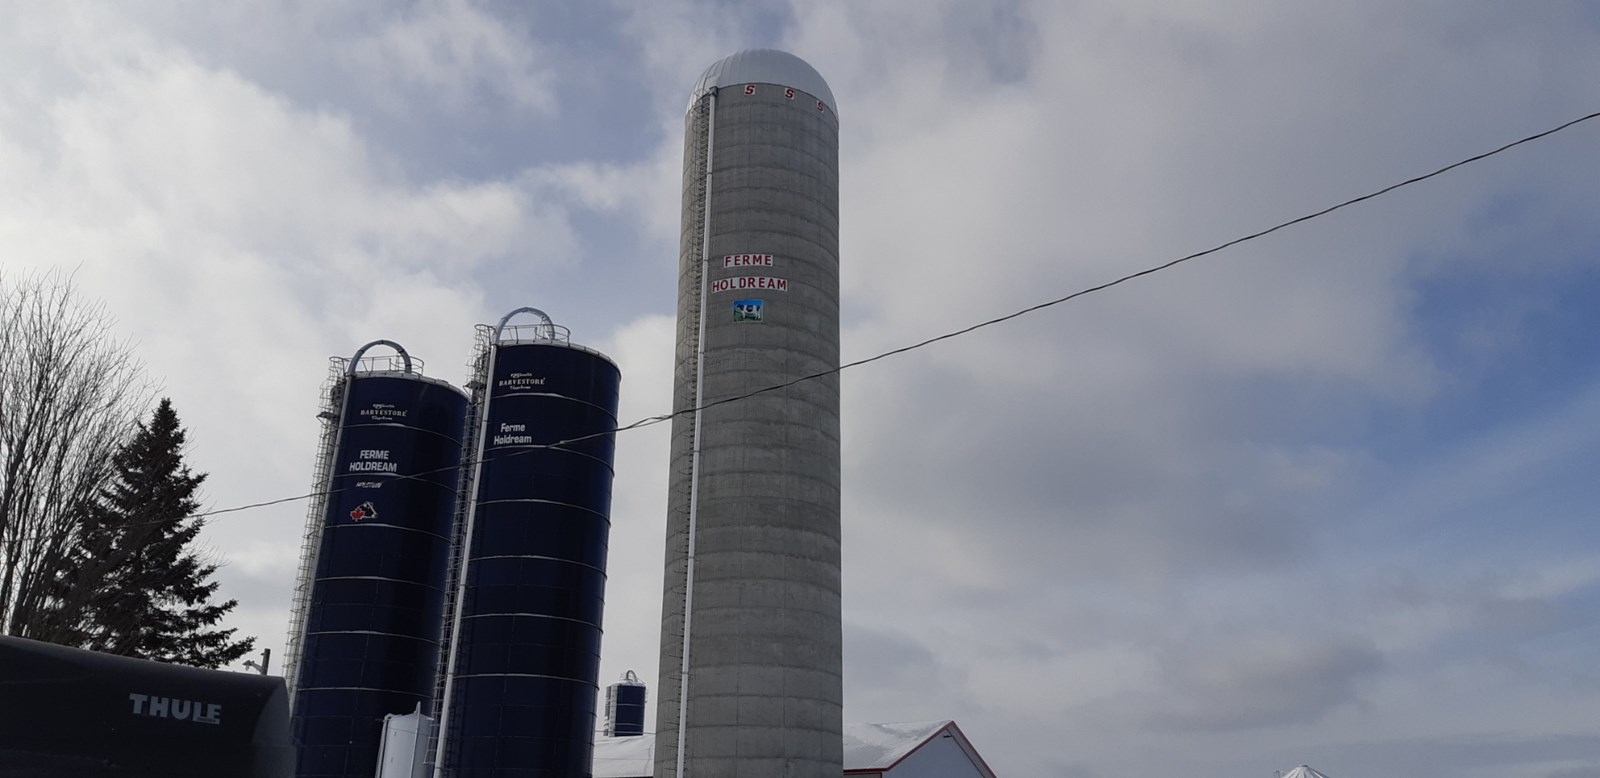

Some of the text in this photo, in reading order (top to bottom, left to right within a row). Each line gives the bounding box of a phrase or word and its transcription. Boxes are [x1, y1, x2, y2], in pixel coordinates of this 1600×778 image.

[745, 85, 755, 95] S
[785, 88, 795, 98] S
[725, 255, 772, 267] FERME
[712, 277, 787, 292] HOLDREAM
[501, 422, 526, 433] Ferme
[494, 434, 532, 445] Holdream
[360, 450, 389, 460] FERME
[349, 461, 397, 472] HOLDREAM
[129, 693, 222, 725] THULE
